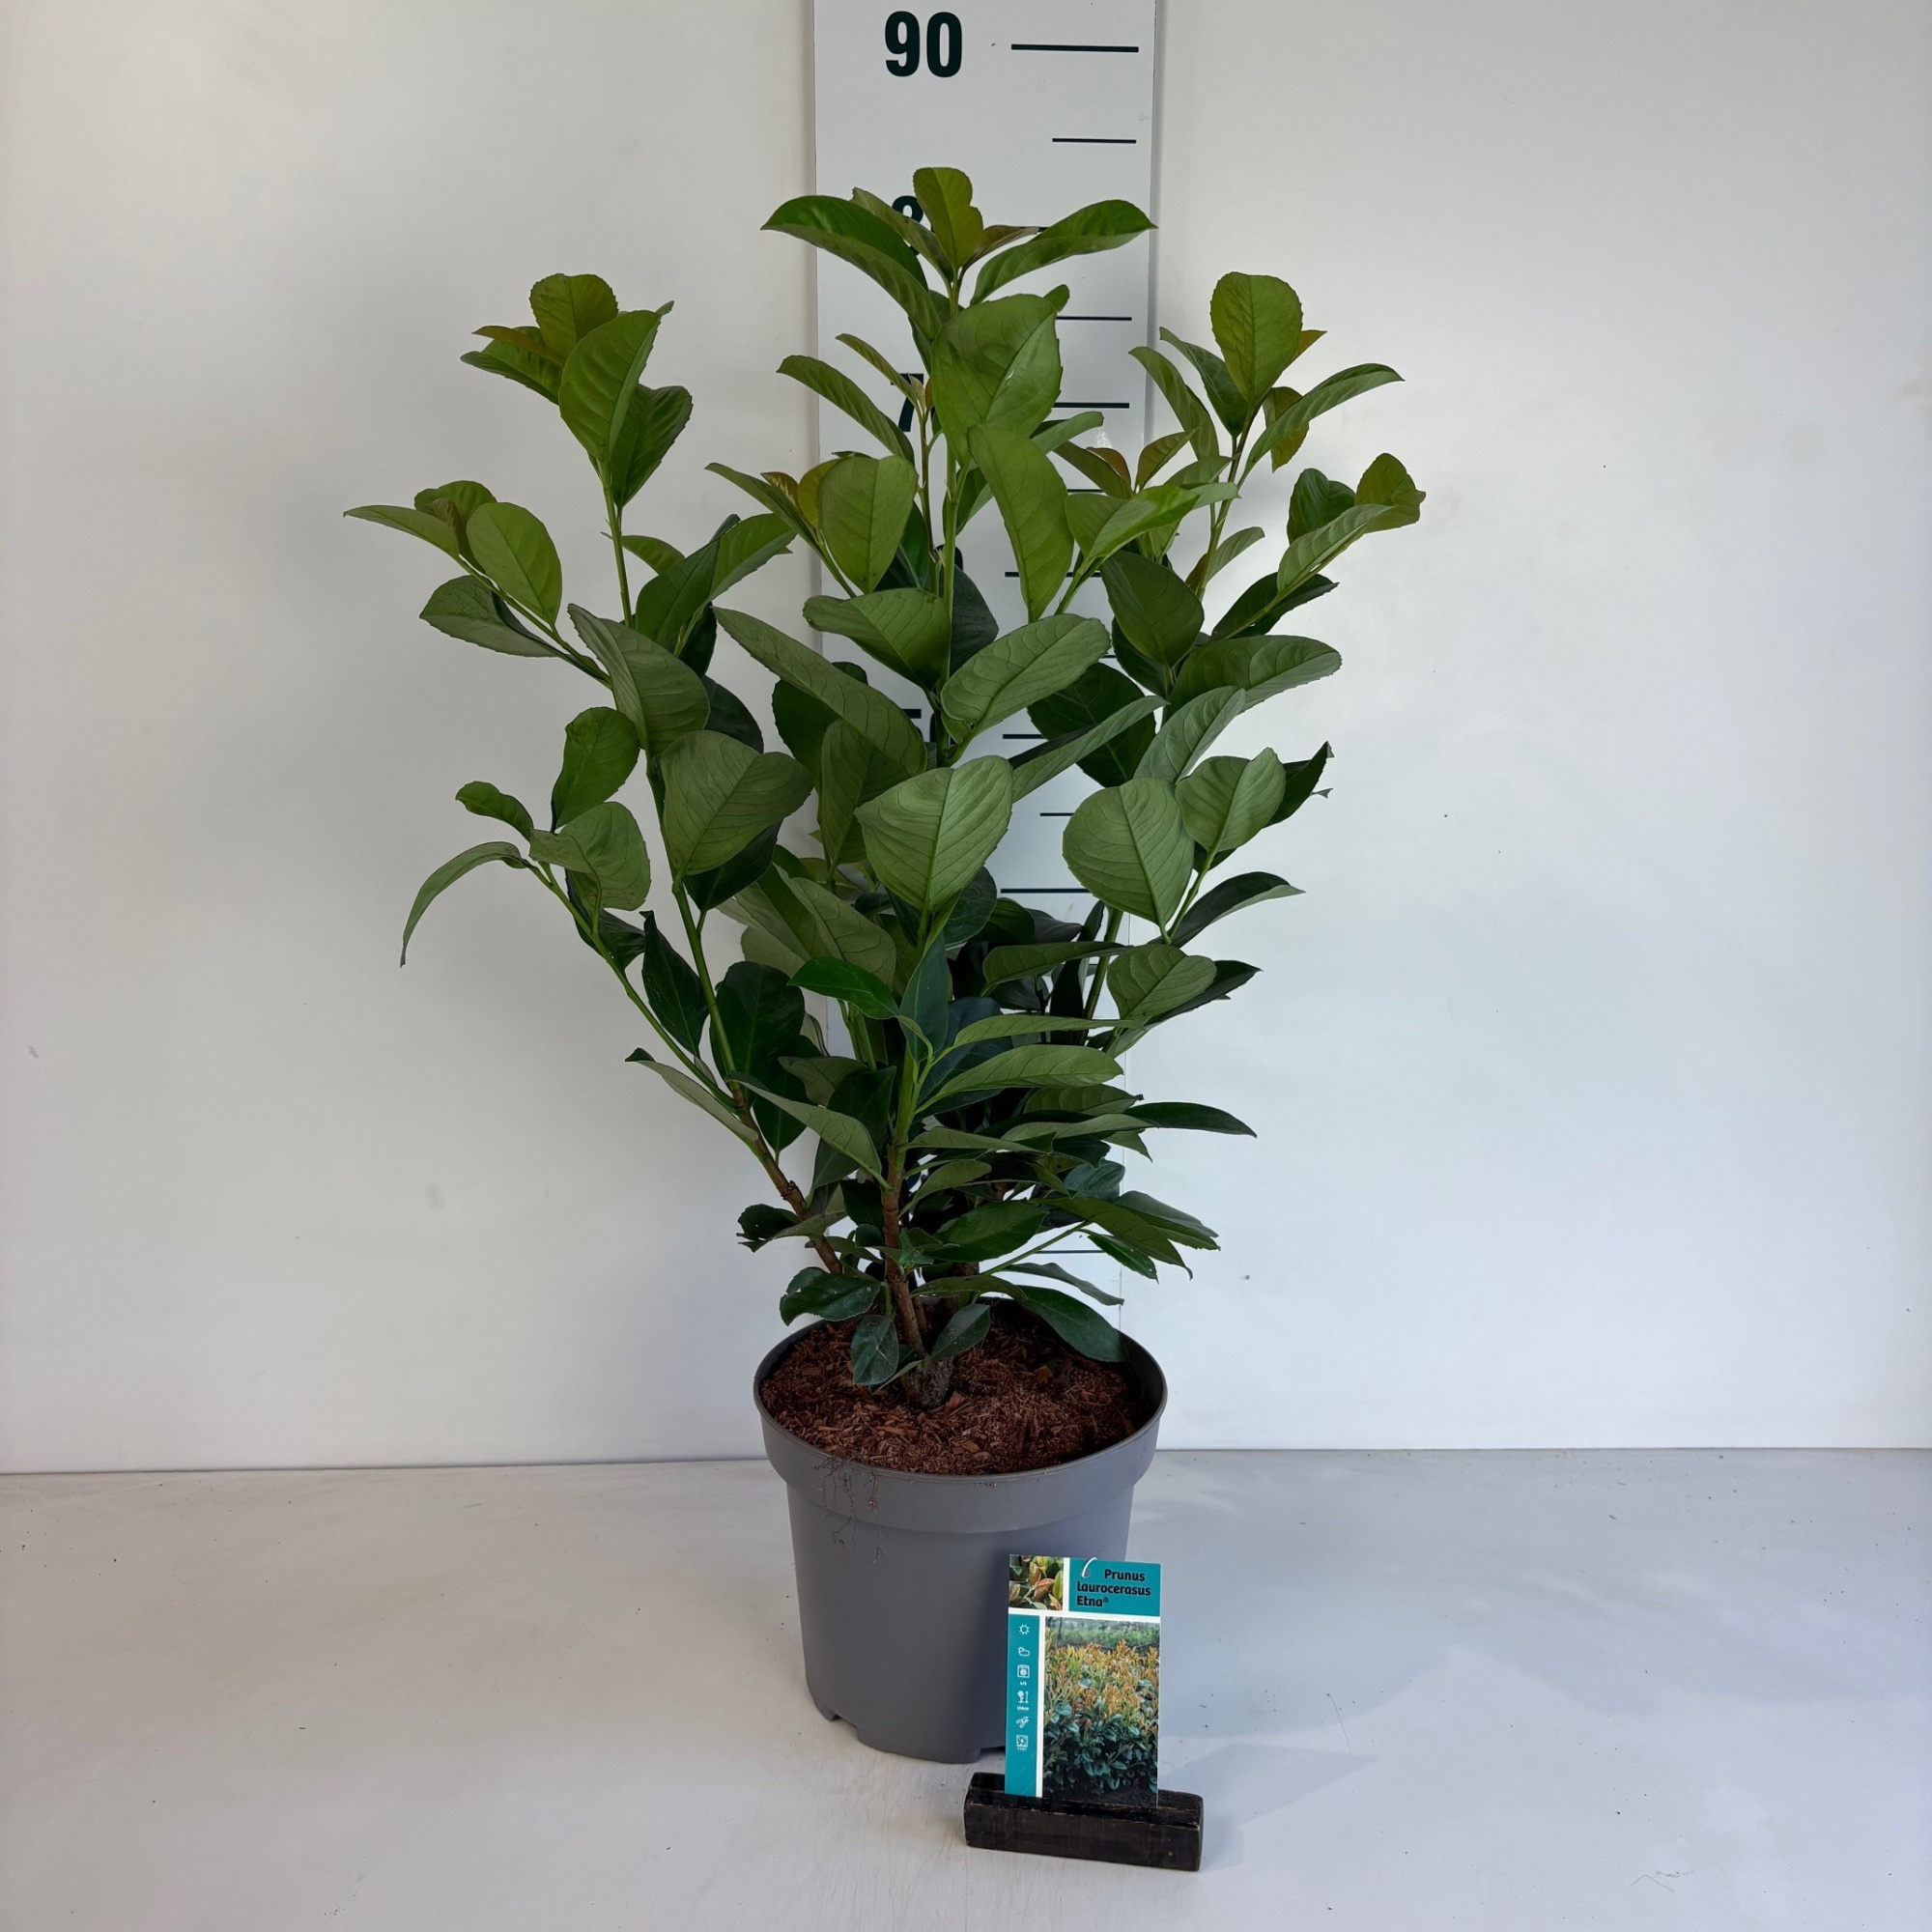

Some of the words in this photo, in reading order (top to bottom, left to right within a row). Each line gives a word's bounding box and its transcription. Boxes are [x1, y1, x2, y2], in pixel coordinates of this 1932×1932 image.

[884, 11, 963, 78] 90
[1104, 1569, 1146, 1582] Prunus
[1076, 1580, 1151, 1597] laurocerasus
